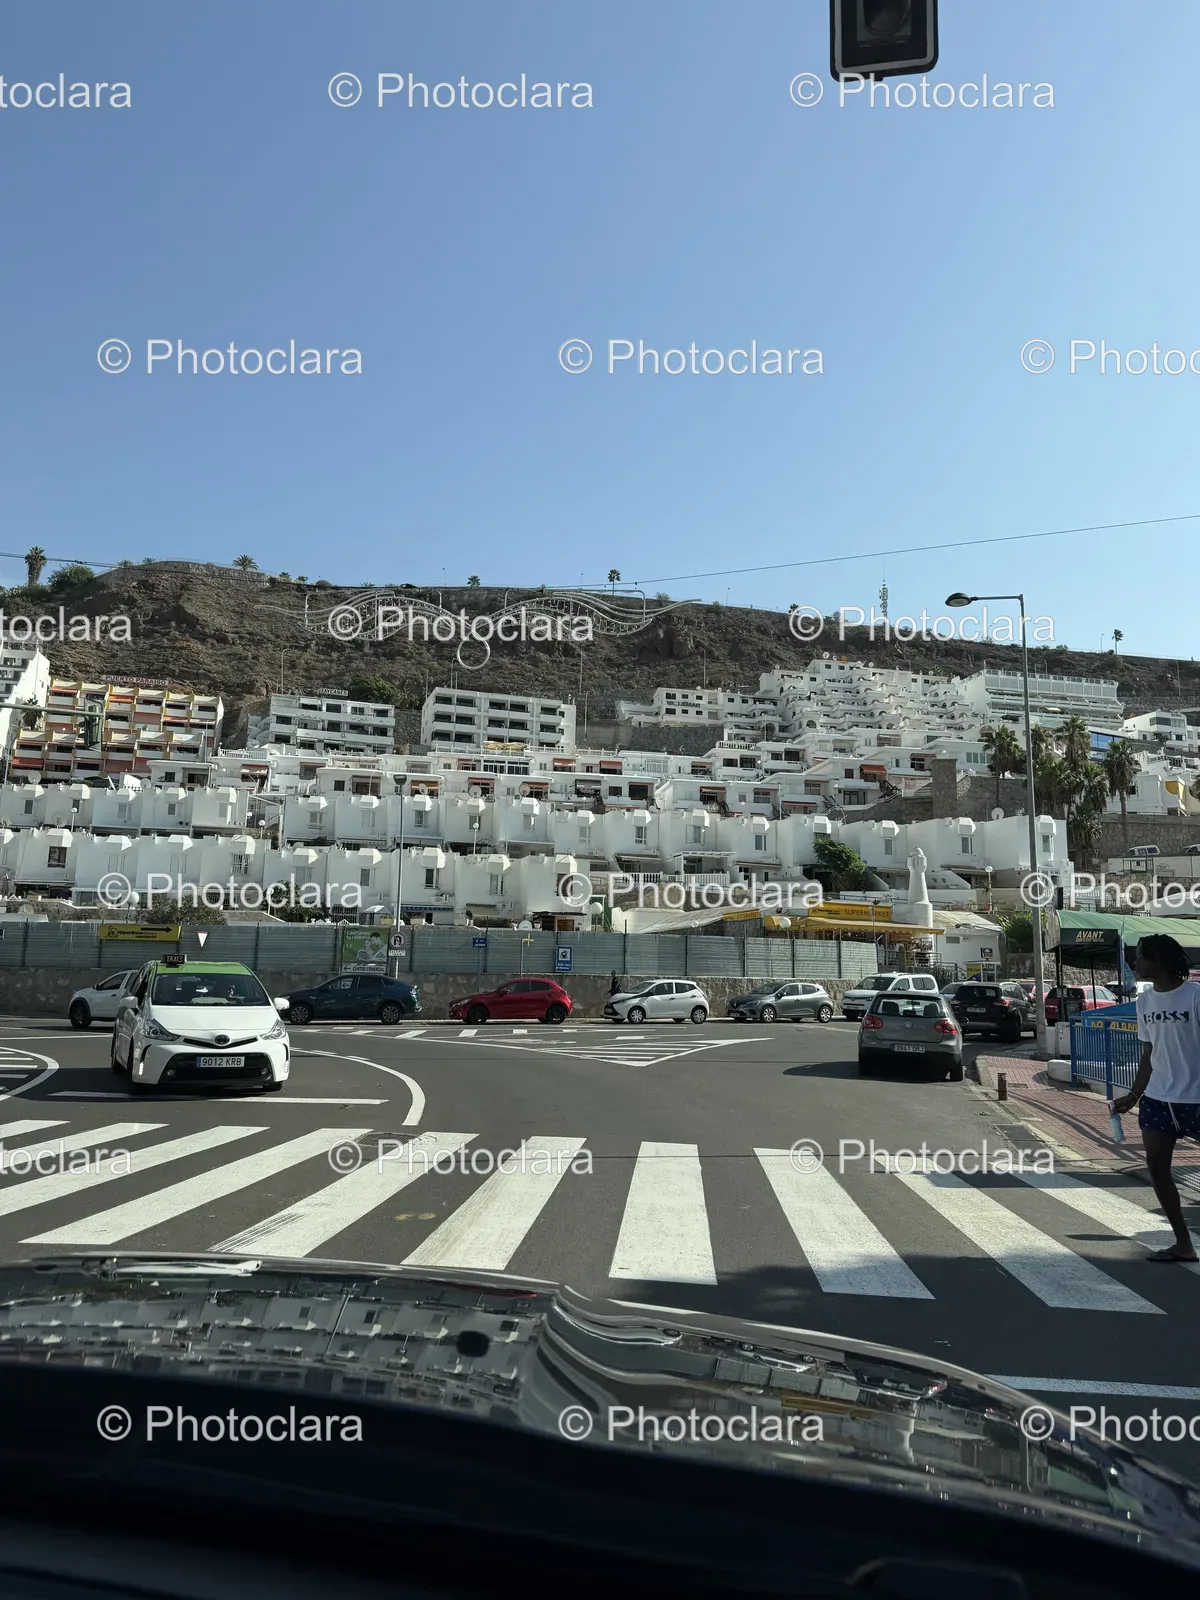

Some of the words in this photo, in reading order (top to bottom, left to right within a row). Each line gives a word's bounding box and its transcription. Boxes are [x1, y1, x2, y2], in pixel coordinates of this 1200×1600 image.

[1076, 931, 1104, 939] AVANT
[1143, 1010, 1190, 1026] BOSS
[202, 1057, 224, 1067] 9012
[225, 1057, 242, 1067] KRB
